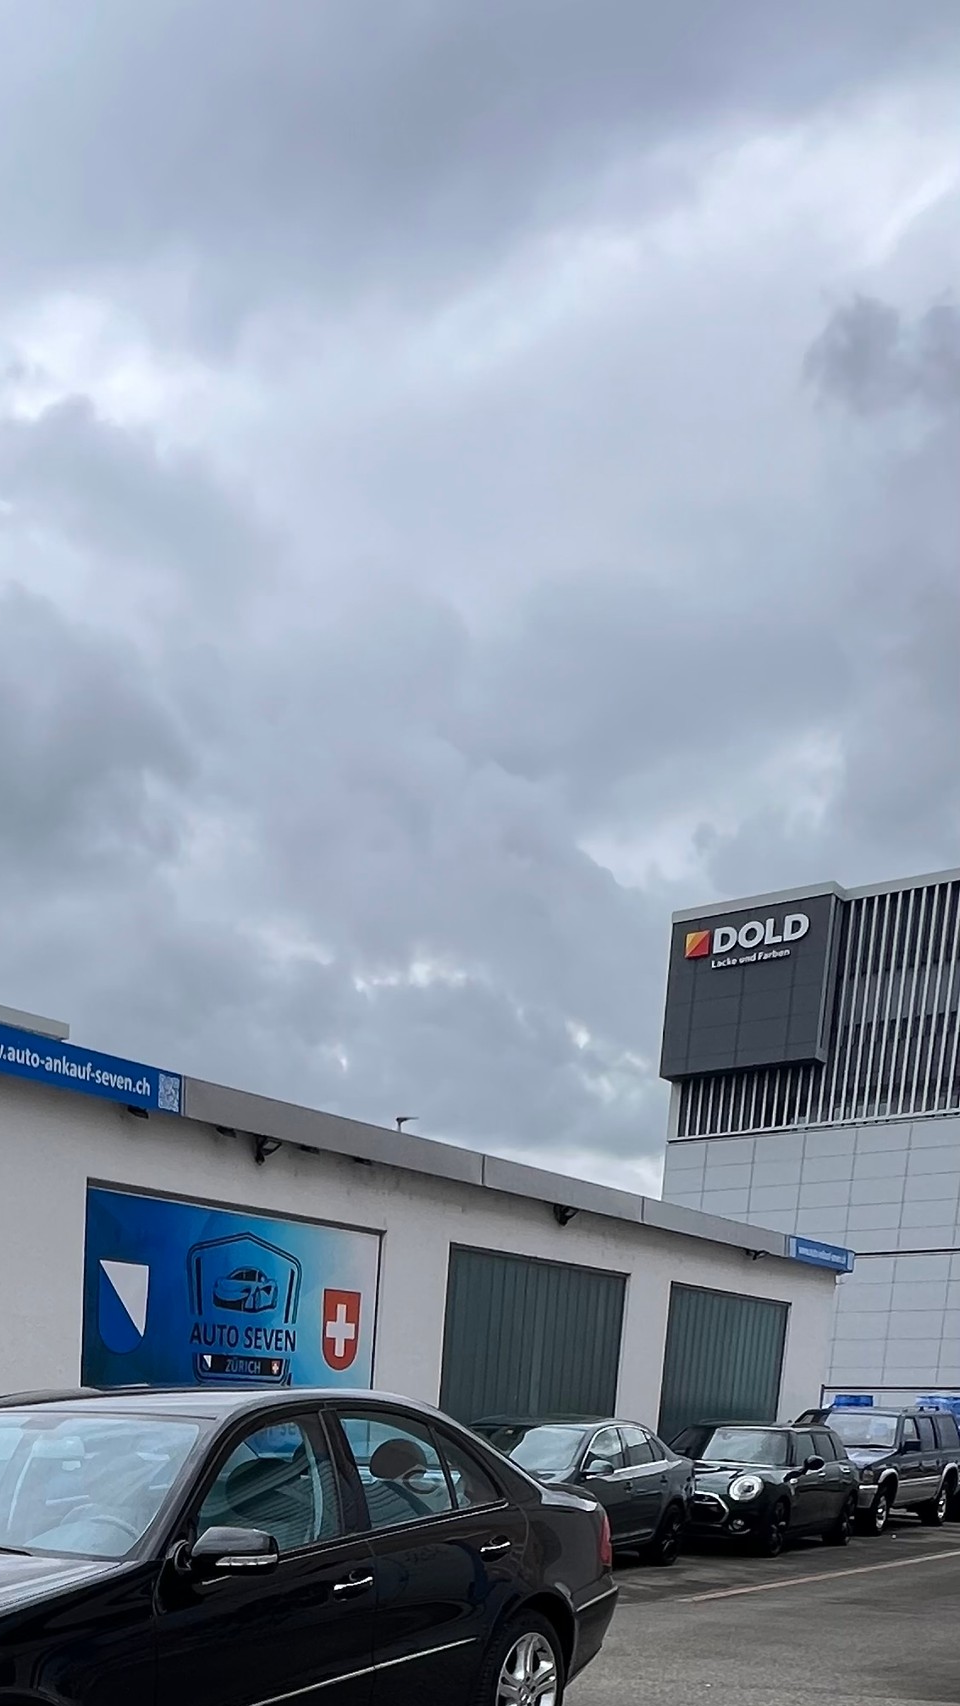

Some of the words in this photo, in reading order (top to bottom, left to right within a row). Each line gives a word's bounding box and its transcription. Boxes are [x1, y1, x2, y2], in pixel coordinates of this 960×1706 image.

[712, 913, 810, 954] DOLD
[711, 958, 738, 969] Lacke
[739, 952, 757, 964] und
[758, 948, 791, 961] Farben
[189, 1322, 239, 1348] AUTO
[243, 1326, 296, 1352] SEVEN
[225, 1357, 261, 1374] ZÜRICH
